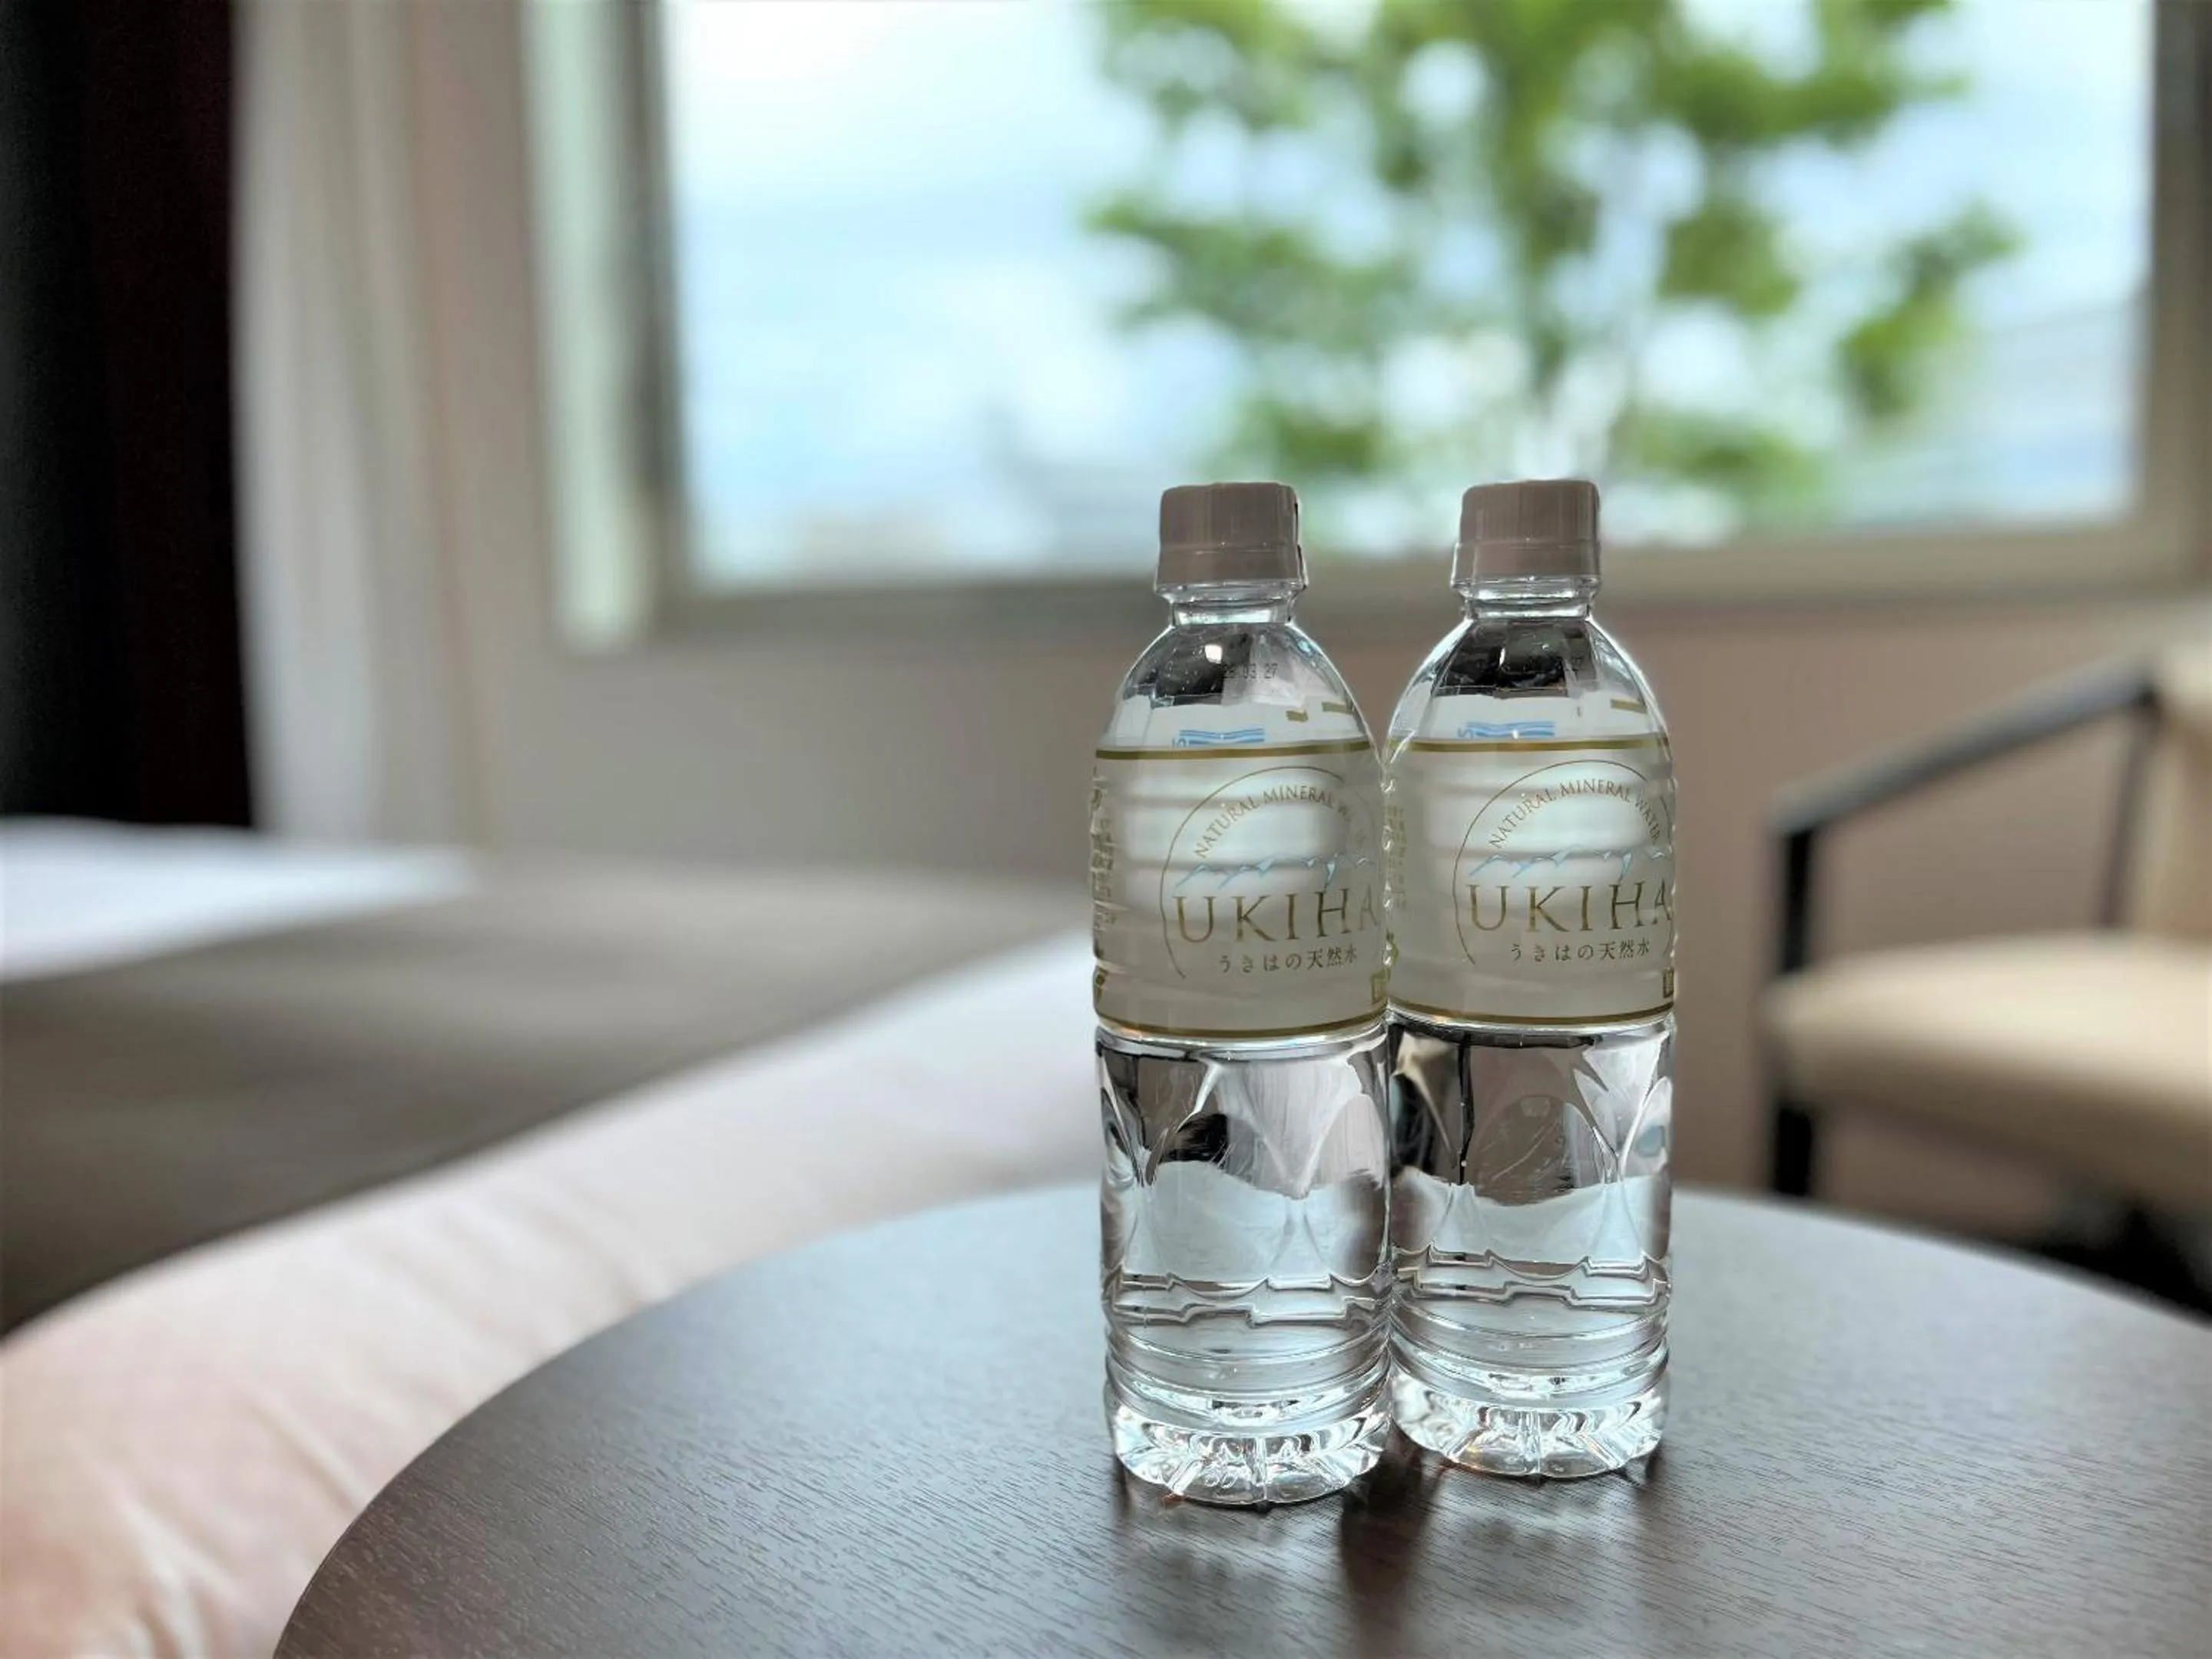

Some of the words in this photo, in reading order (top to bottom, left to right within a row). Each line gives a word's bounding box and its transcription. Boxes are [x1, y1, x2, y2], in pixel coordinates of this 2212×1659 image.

[1194, 795, 1260, 859] NATURAL
[1263, 785, 1334, 810] MINERAL
[1489, 787, 1557, 849] NATURAL
[1559, 778, 1631, 803] MINERAL
[1173, 886, 1379, 943] UKIHA
[1466, 879, 1672, 932] UKIHA
